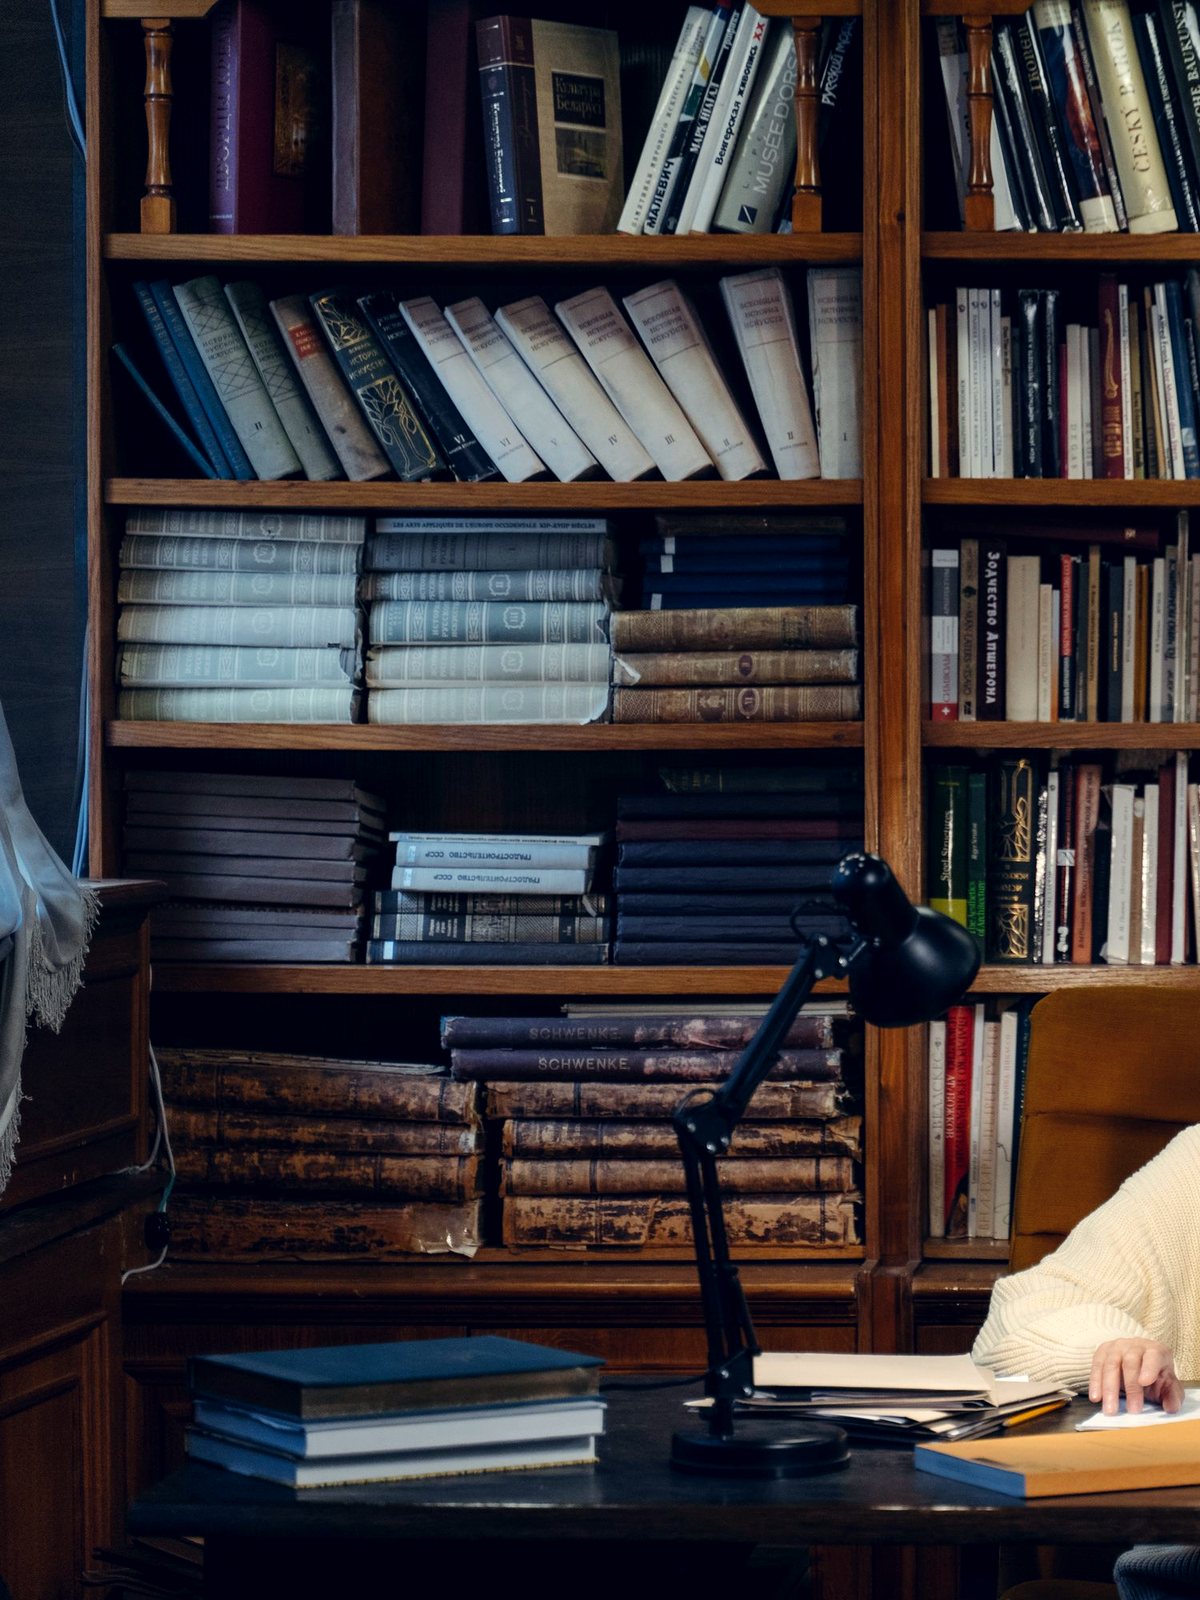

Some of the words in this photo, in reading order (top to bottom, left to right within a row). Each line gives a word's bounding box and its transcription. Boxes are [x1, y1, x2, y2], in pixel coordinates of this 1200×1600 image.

[1102, 21, 1135, 97] BAROK
[1170, 0, 1200, 81] BAUKUNST
[697, 80, 721, 122] ШАГАЛ
[713, 100, 744, 166] Венгерская
[734, 44, 761, 98] живопись
[688, 122, 708, 155] МАРК
[749, 117, 786, 195] MUSÉE
[1120, 105, 1152, 174] ČESKÝ
[645, 159, 675, 229] МАЛЕВИЧ
[1157, 314, 1166, 339] Alfred
[1160, 340, 1169, 363] Frank
[453, 433, 466, 445] VI
[984, 551, 1001, 626] ЗОДЧЕСТВО
[985, 631, 999, 704] АПШЕРОНА
[939, 808, 953, 855] Structures
[448, 850, 531, 861] ГРАДОСТРОИТЕЛЬСТВО
[939, 858, 950, 880] Steel
[456, 873, 540, 884] ГРАДОСТРОИТЕЛЬСТВО
[976, 879, 984, 925] Architecture
[528, 1026, 618, 1040] SCHWENKE
[538, 1057, 628, 1070] SCHWENKE
[944, 1096, 954, 1138] БОЖКОВ
